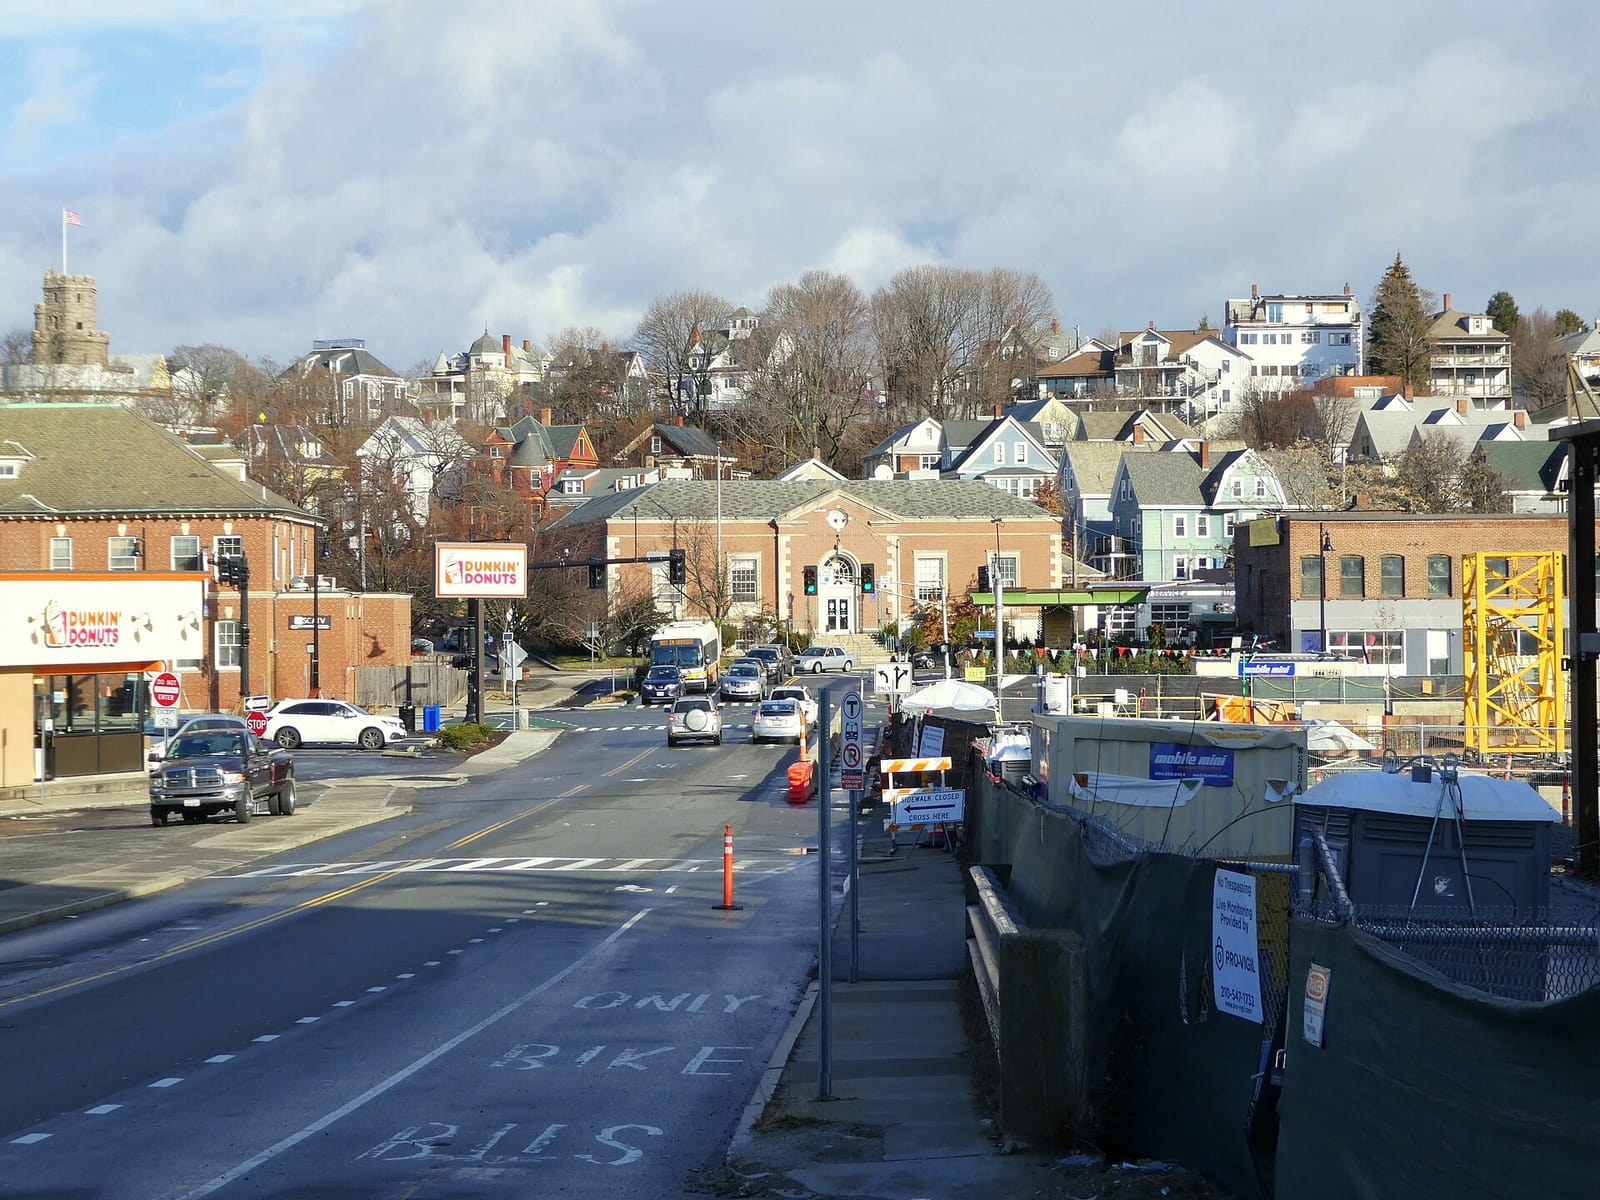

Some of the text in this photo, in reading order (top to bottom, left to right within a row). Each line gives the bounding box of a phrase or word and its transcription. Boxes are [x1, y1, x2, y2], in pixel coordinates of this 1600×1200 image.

[464, 561, 520, 573] DUNKIN'
[464, 573, 517, 585] DONUTS
[69, 611, 122, 627] DUNKIN'
[69, 628, 119, 644] DONUTS
[846, 700, 858, 717] T
[247, 719, 267, 730] STOP
[1154, 751, 1229, 766] mobile mini
[901, 793, 960, 804] SIDEWALK CLOSED
[932, 812, 951, 820] HERE
[1216, 876, 1252, 897] No Trespassing
[1216, 897, 1253, 920] Live Monitoring
[1220, 913, 1249, 934] Provided by
[1225, 950, 1256, 973] PRO-VIGIL
[573, 992, 762, 1014] ONLY
[1220, 985, 1255, 1007] 210-547-1732
[488, 1043, 754, 1076] BIKE
[353, 1122, 664, 1167] BUS
